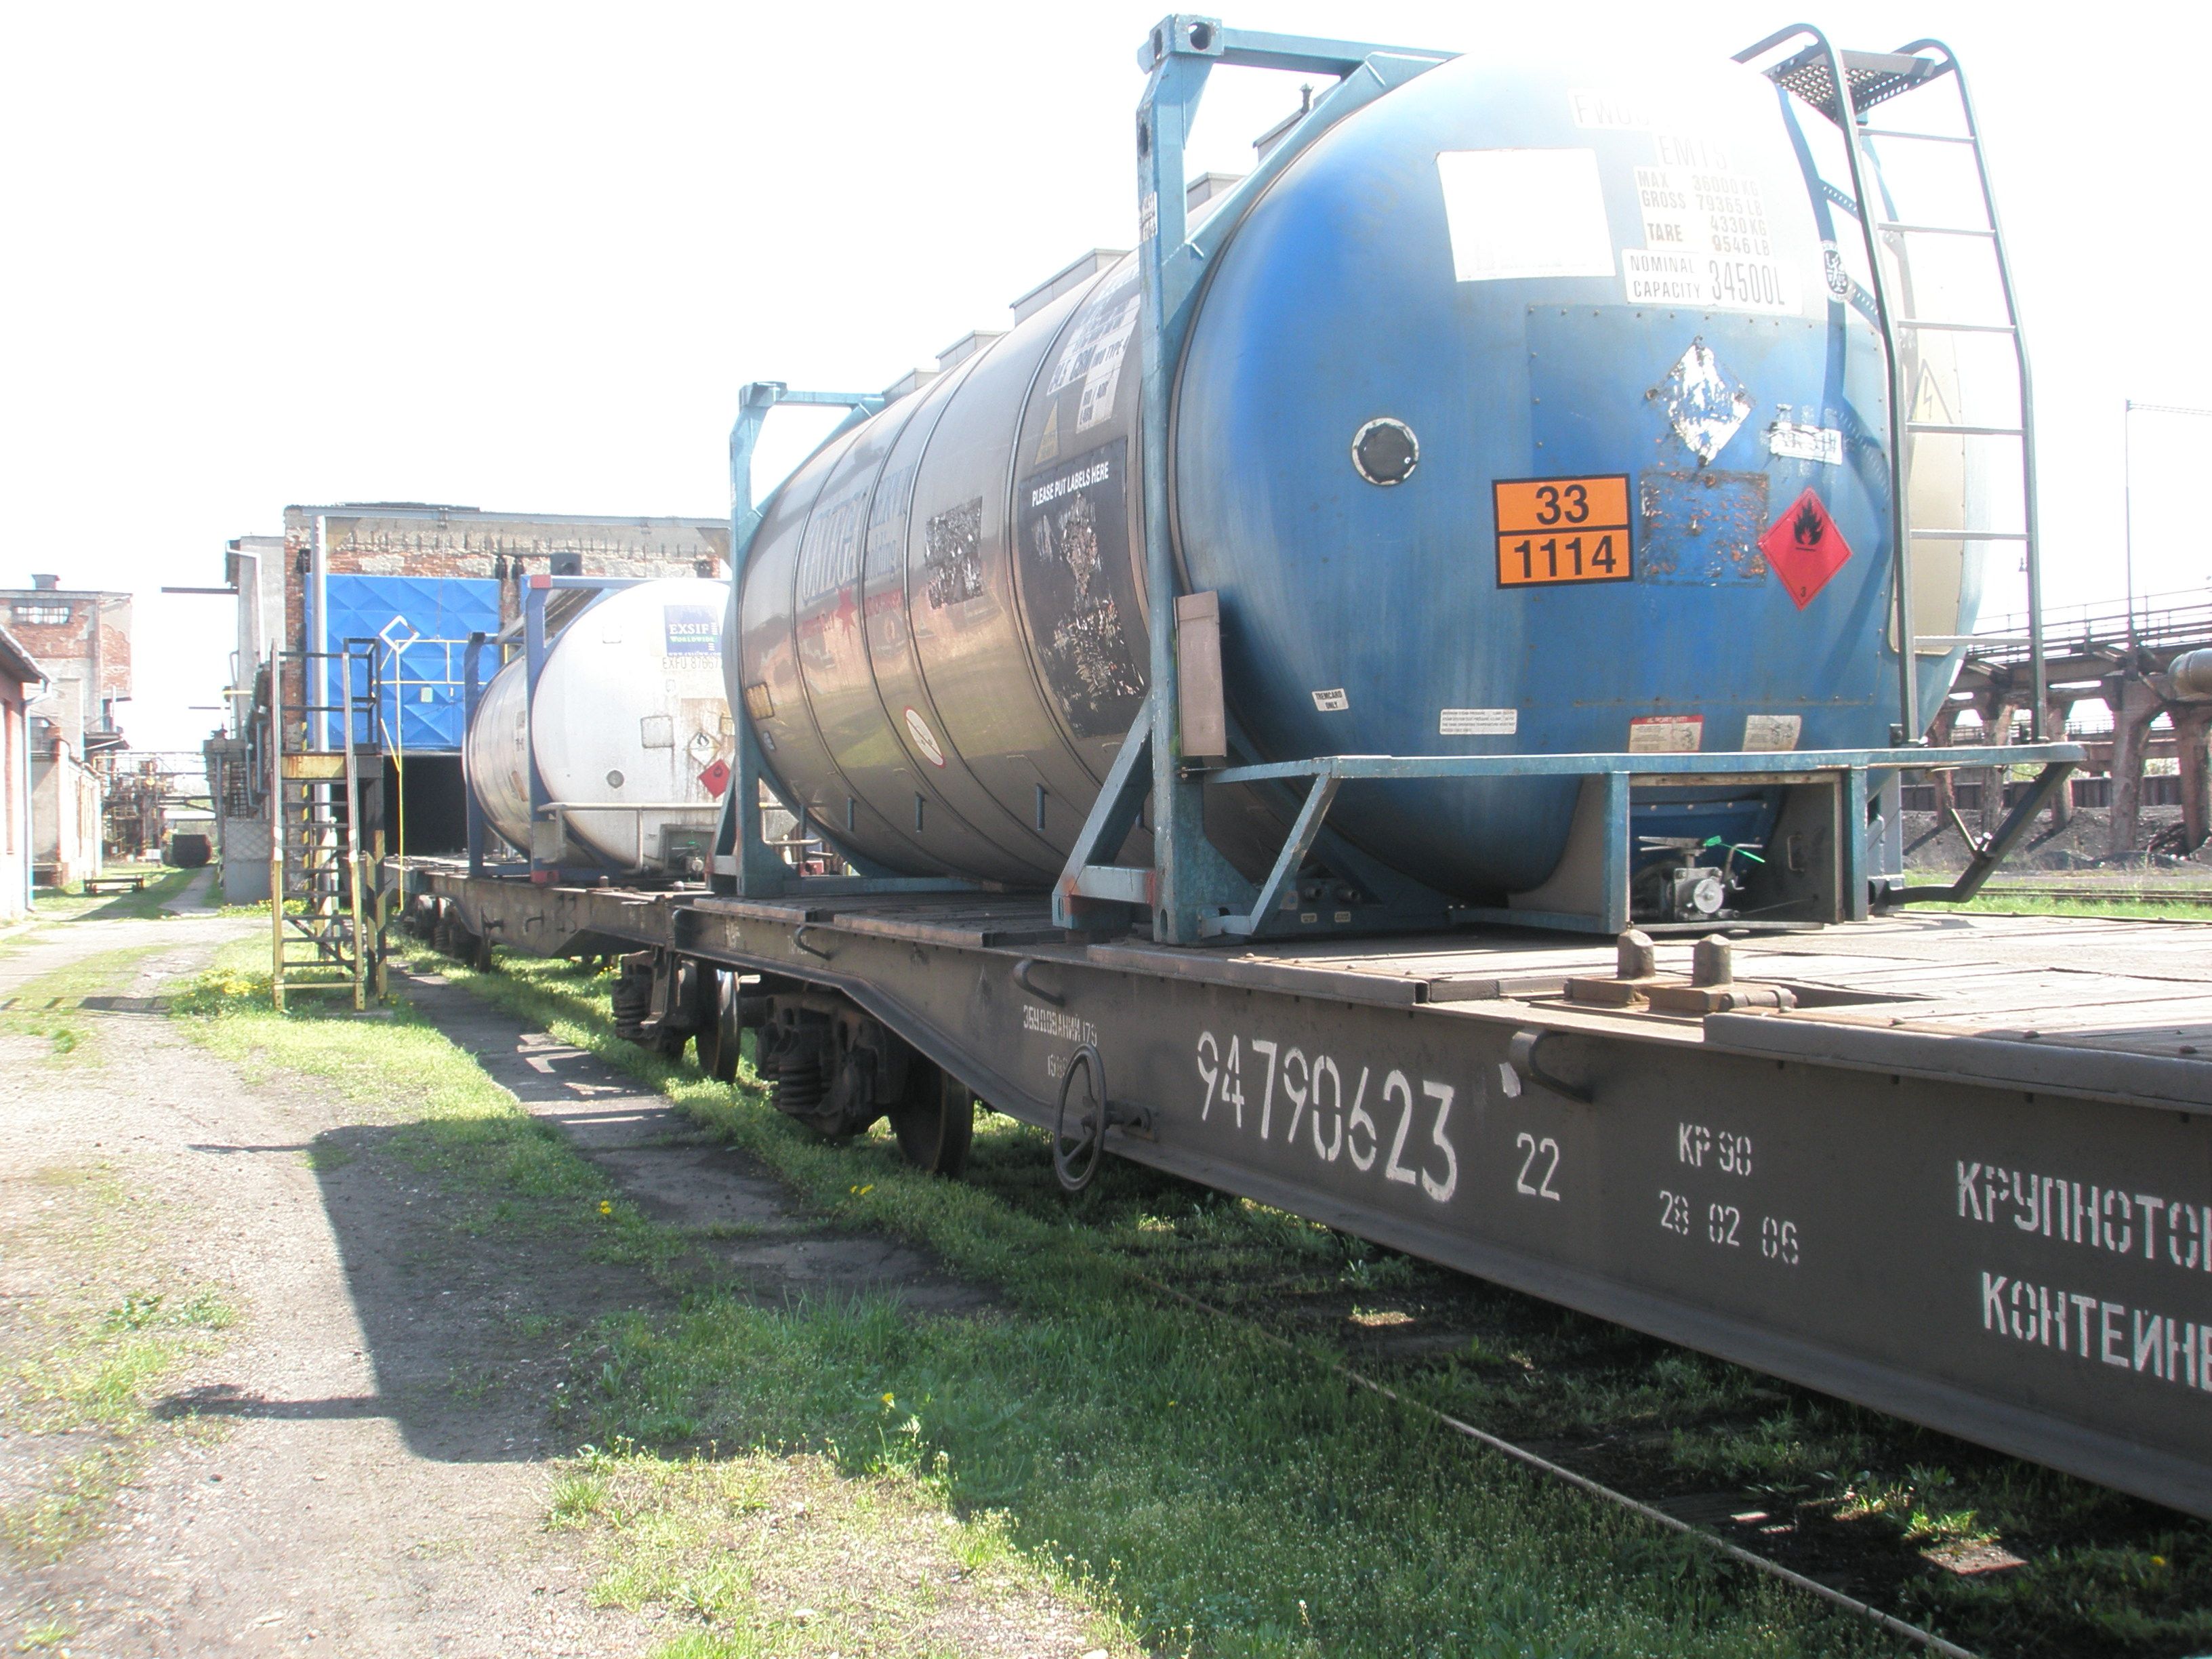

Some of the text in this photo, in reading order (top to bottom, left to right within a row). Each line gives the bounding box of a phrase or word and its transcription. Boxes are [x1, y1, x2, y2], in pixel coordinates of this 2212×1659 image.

[1637, 171, 1670, 188] MAX
[1740, 179, 1759, 197] KG
[1641, 190, 1763, 216] GROSS 79365 LB
[1647, 223, 1684, 243] TARE
[1754, 239, 1770, 256] LB
[1710, 215, 1767, 237] 4330 KG
[1630, 255, 1786, 306] NOMINAL 34500L
[1633, 280, 1701, 299] CAPACITY
[1032, 461, 1109, 507] PLEASE PUT LABELS HERE
[1535, 484, 1590, 525] 33
[1513, 535, 1617, 579] 1114
[1800, 586, 1807, 599] 3
[669, 623, 709, 634] EXSIF
[662, 657, 687, 670] EXFU
[1325, 701, 1338, 710] ONLY
[1196, 1031, 1458, 1203] 94790623
[1516, 1132, 1560, 1202] 22
[1719, 1131, 1752, 1176] 90
[1659, 1189, 1799, 1265] 28 02 06
